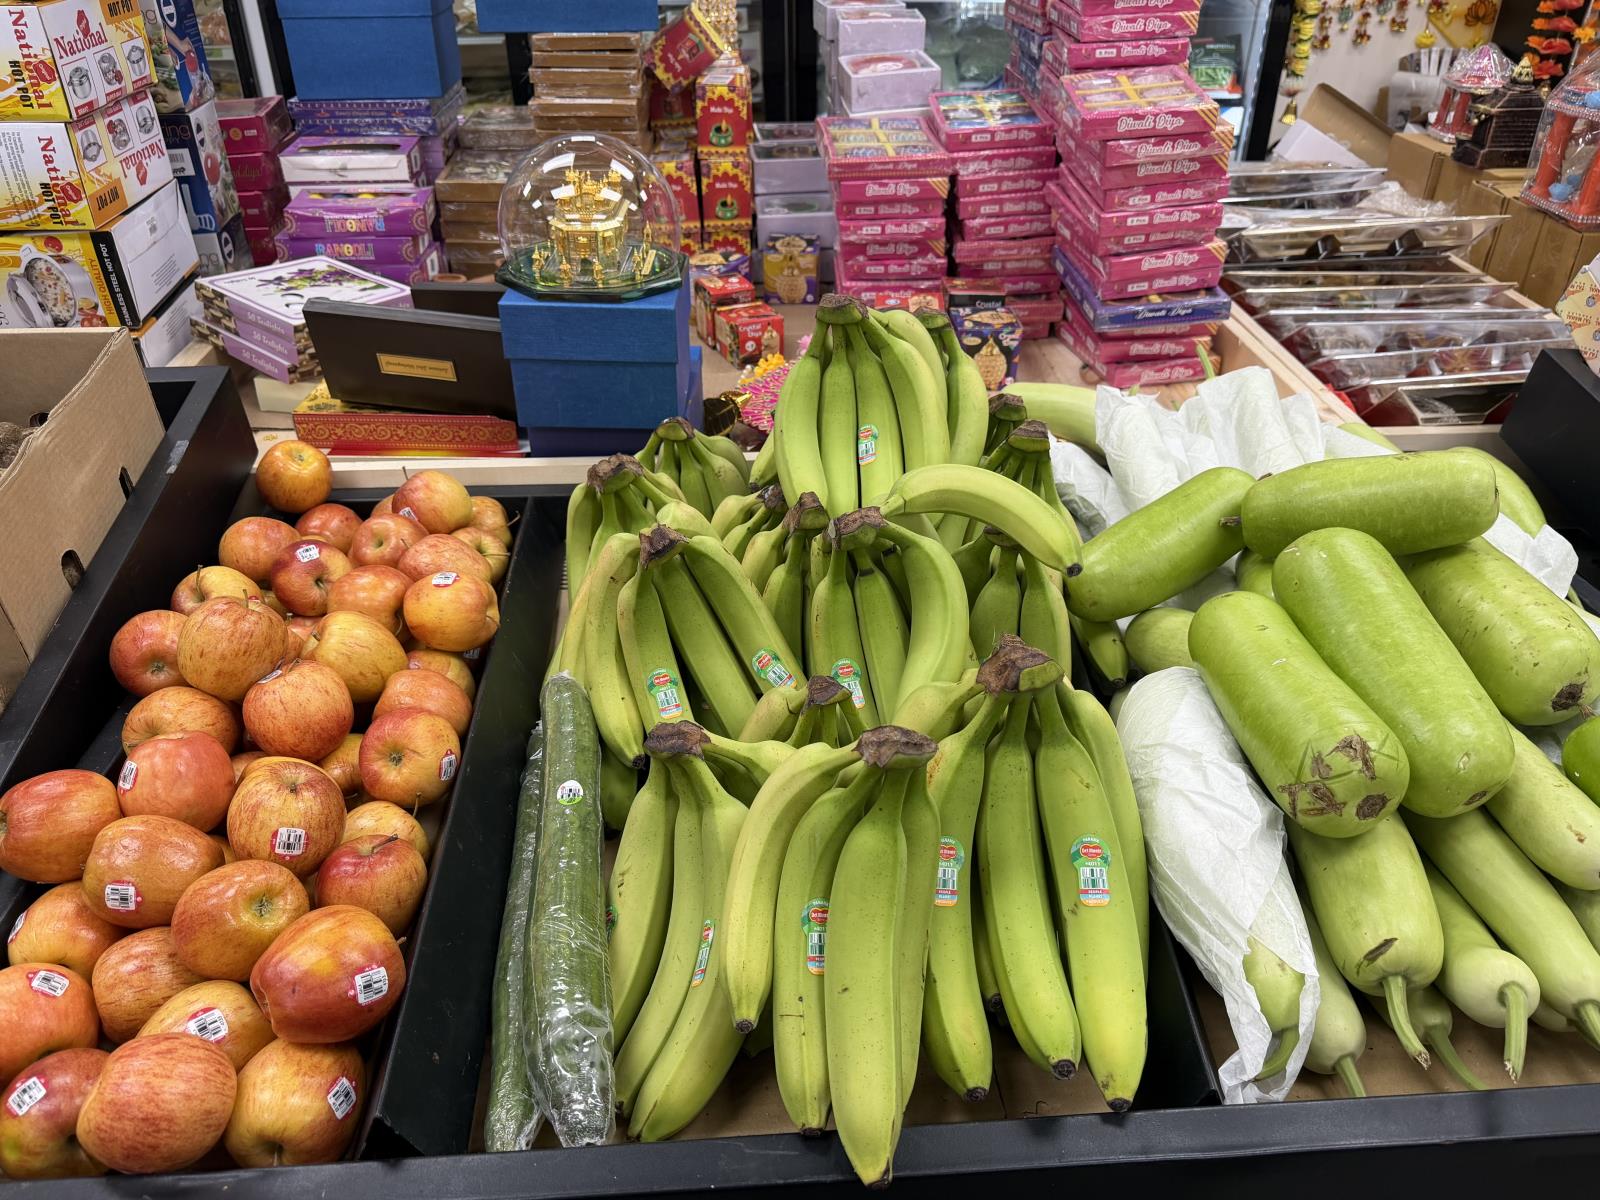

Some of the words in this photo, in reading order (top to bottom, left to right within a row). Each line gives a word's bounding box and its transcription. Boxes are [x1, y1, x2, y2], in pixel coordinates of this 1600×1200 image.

[108, 2, 121, 18] HOT
[121, 0, 133, 14] POT
[1112, 18, 1145, 33] Diwali
[1146, 17, 1171, 33] Diya
[54, 22, 108, 59] National
[8, 9, 53, 109] National
[9, 61, 26, 84] HOT
[17, 87, 34, 109] POT
[1117, 116, 1153, 132] Diwali
[1156, 114, 1184, 130] Diya
[1137, 143, 1173, 158] Diwali
[1175, 139, 1200, 152] Diya
[119, 139, 165, 178] National
[1137, 161, 1172, 176] Diwali
[1174, 158, 1200, 173] Diya
[38, 136, 86, 226] National
[108, 186, 120, 203] HOT
[866, 183, 896, 197] Diwali
[897, 183, 920, 198] Diya
[40, 182, 55, 206] HOT
[50, 205, 64, 226] POT
[97, 195, 108, 211] POT
[324, 217, 385, 232] RANGOLI
[100, 243, 109, 257] POT
[315, 243, 375, 258] RANGOLI
[105, 258, 115, 272] HOT
[1141, 255, 1173, 271] Diwali
[1174, 252, 1199, 266] Diya
[89, 258, 108, 297] QUALITY
[110, 272, 121, 293] STEEL
[103, 299, 115, 315] HIGH
[117, 293, 133, 326] STAINLESS
[1135, 307, 1167, 320] Diwali
[1169, 304, 1193, 317] Diya
